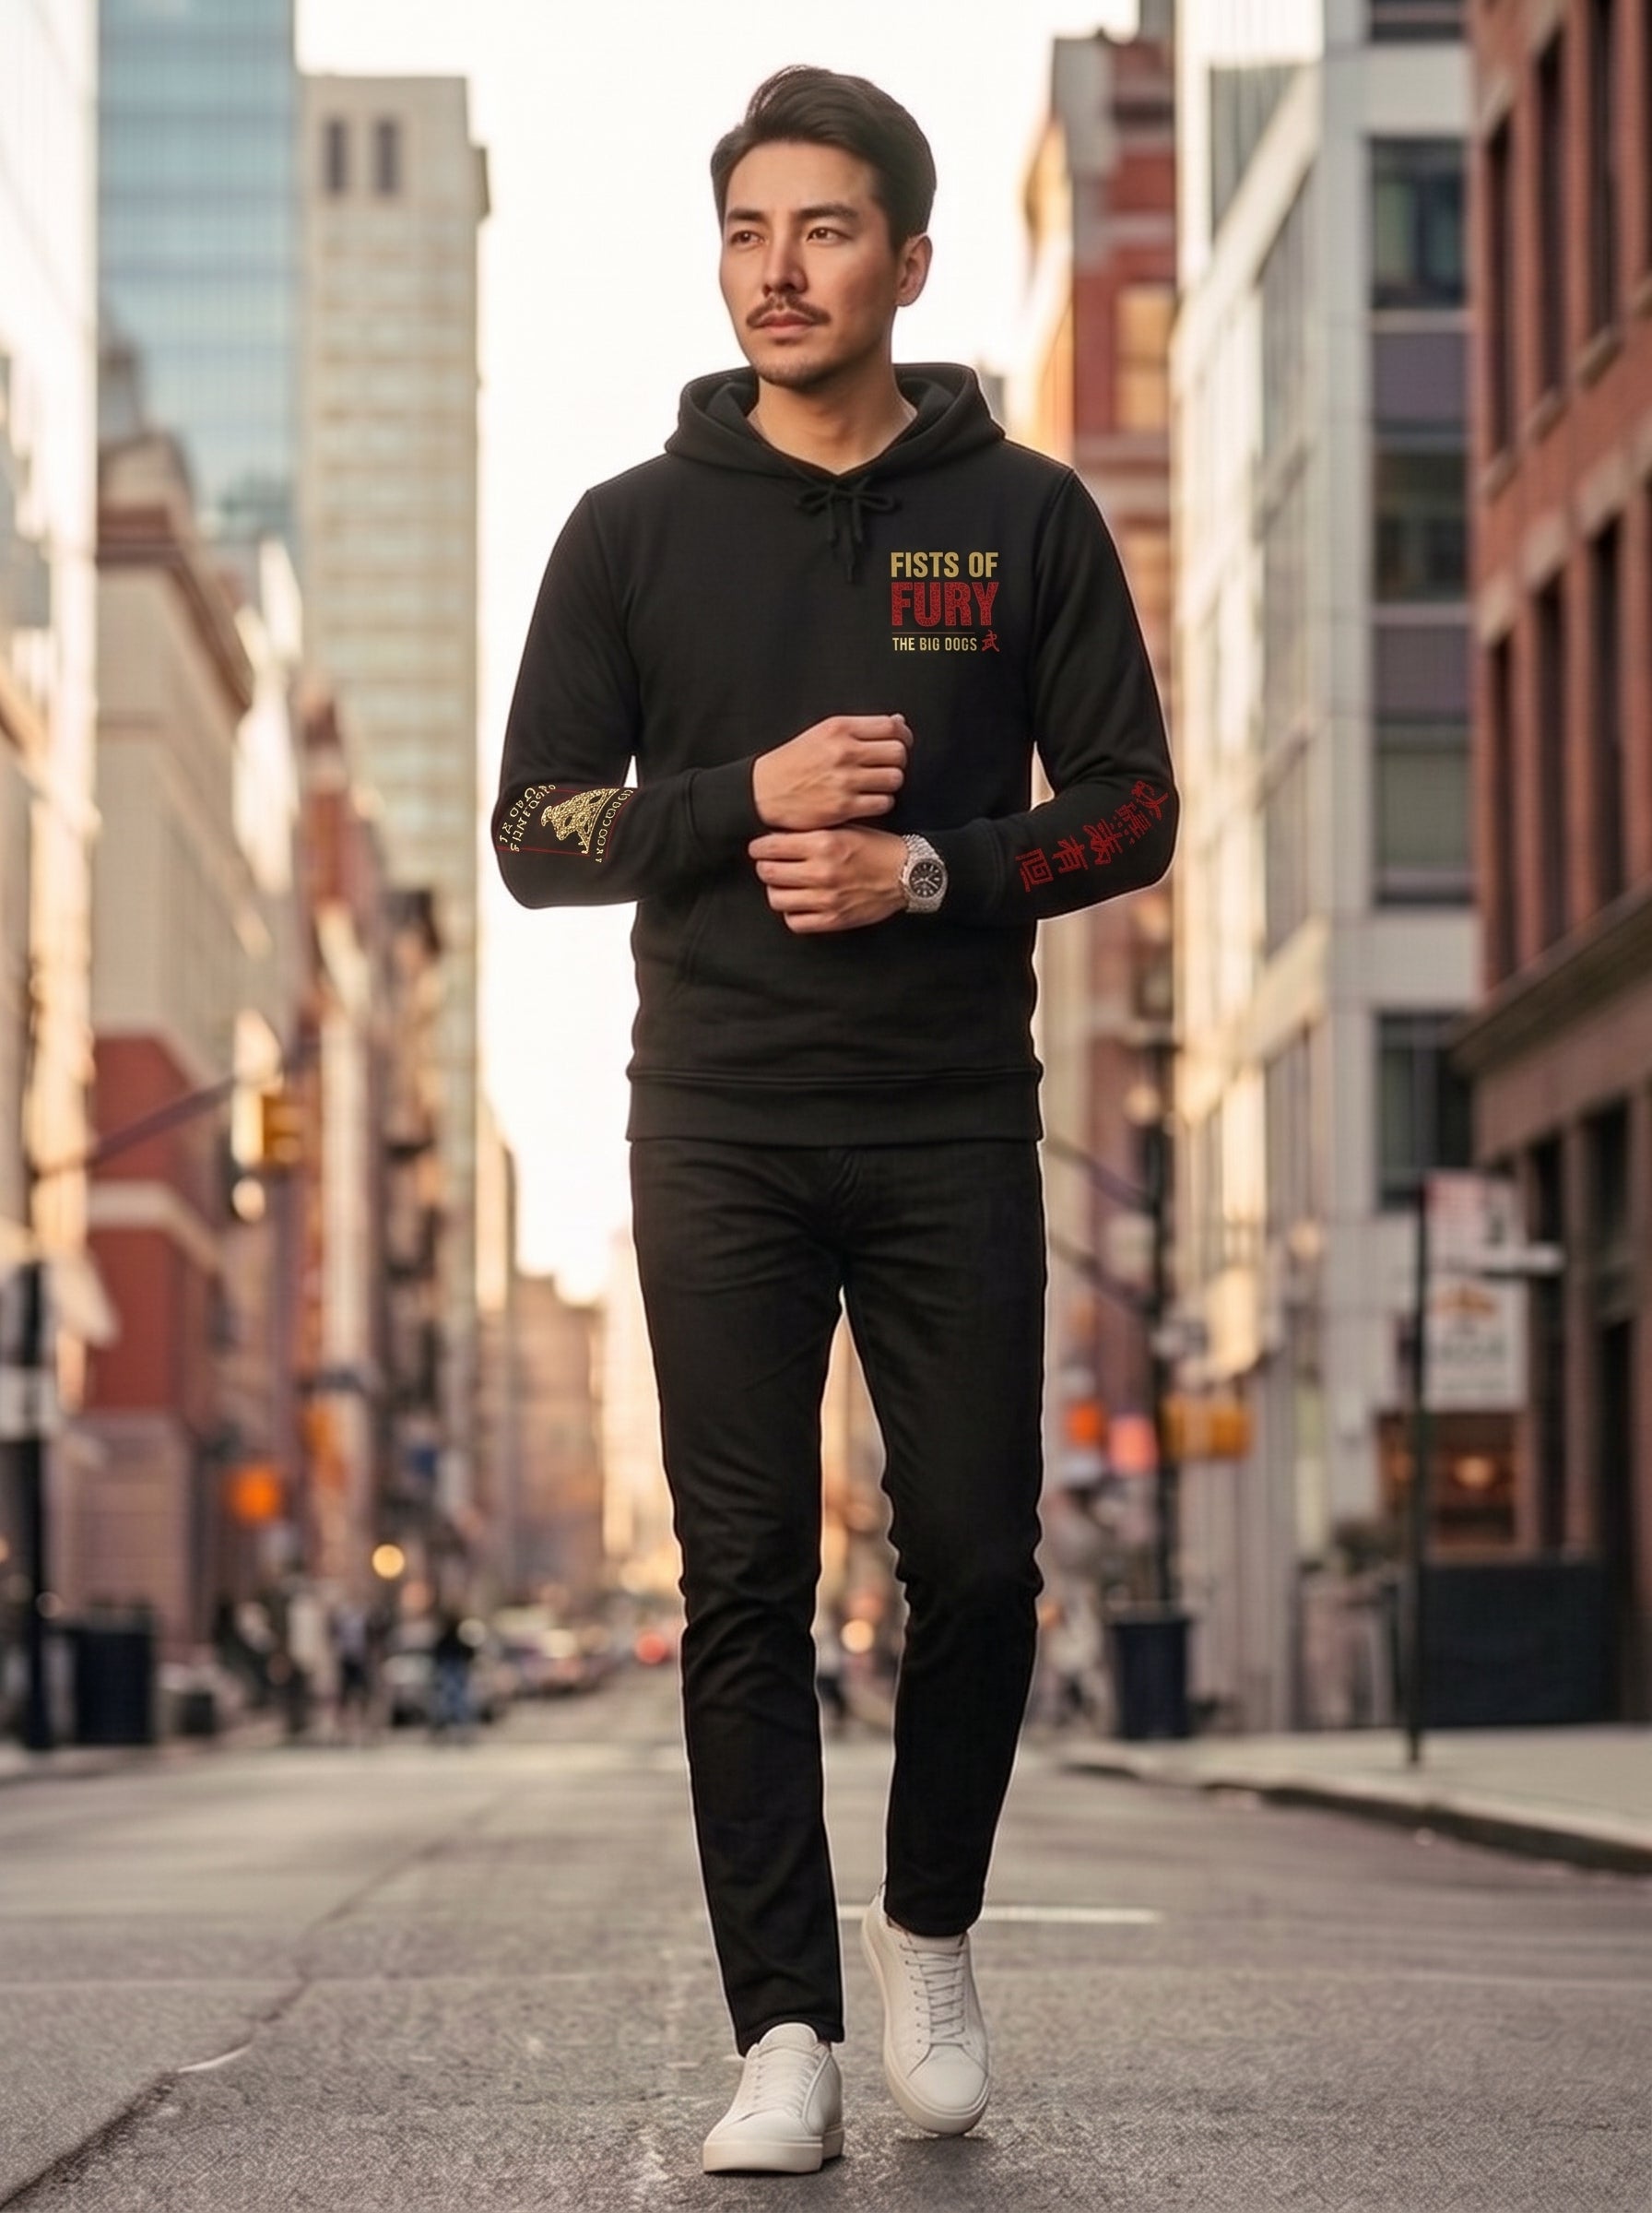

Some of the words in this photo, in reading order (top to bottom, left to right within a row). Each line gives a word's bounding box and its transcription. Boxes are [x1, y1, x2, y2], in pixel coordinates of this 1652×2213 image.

[891, 551, 960, 578] FISTS
[968, 551, 999, 578] OF
[891, 581, 999, 627] FURY
[891, 637, 915, 652] THE
[919, 637, 940, 652] BIG
[944, 637, 978, 652] DOGS
